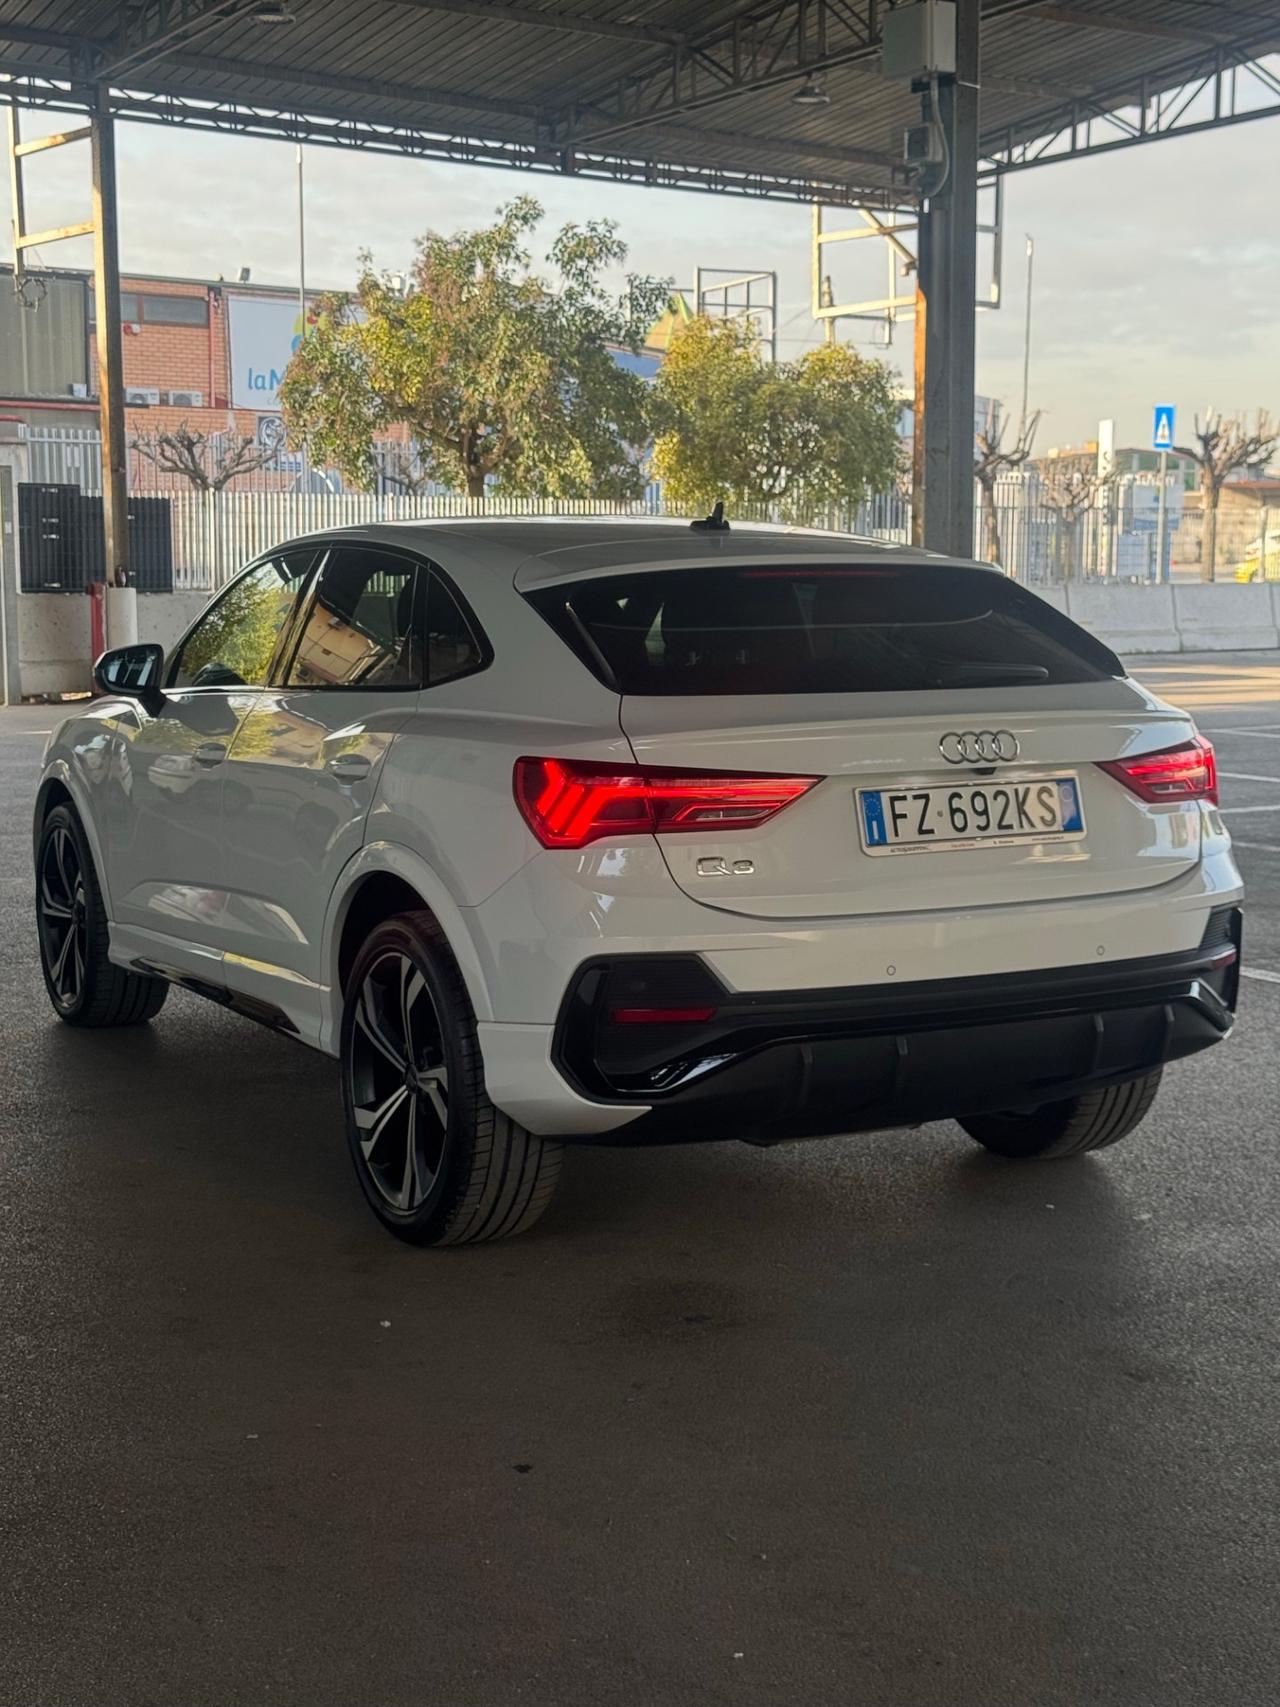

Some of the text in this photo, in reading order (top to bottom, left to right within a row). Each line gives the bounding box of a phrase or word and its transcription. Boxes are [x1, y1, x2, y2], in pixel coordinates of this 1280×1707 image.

[889, 785, 1057, 837] FZ 692KS
[697, 856, 754, 876] Q3
